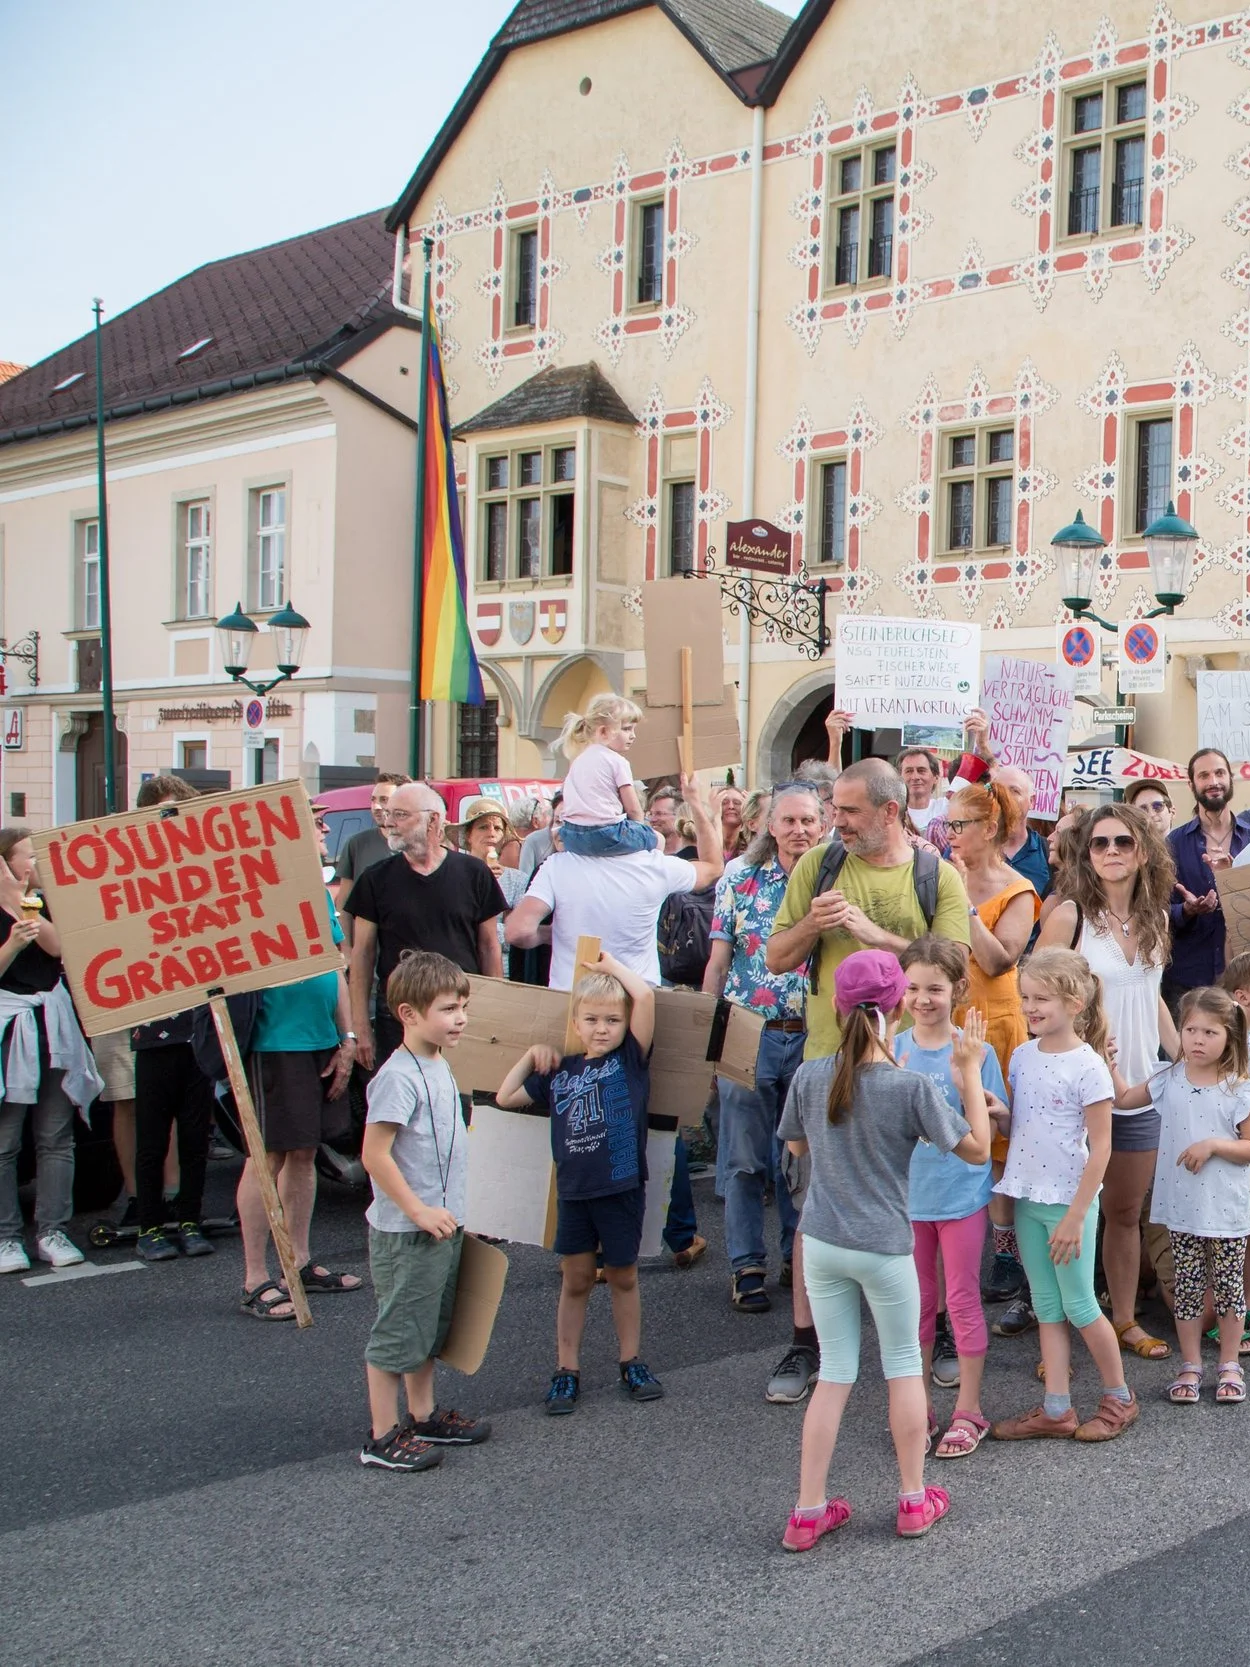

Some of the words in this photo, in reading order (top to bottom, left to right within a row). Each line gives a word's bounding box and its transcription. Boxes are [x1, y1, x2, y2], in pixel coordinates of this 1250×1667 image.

[730, 536, 788, 559] alexander
[843, 625, 956, 643] STEINBRUCHSEE
[846, 646, 872, 657] NSG
[874, 646, 949, 660] TEUFELSTEIN
[845, 674, 890, 687] SANFTE
[894, 675, 952, 689] NUTZUNG
[1001, 660, 1055, 684] NATUR-
[840, 697, 860, 713] MIT
[864, 697, 973, 716] VERANTWORTUNG
[1094, 711, 1134, 721] Parkscheine
[1202, 702, 1232, 727] AM
[989, 723, 1051, 749] NUTZUNG
[1001, 745, 1036, 766] STATT
[1073, 750, 1114, 775] SEE
[48, 795, 301, 886] LÖSUNGEN
[99, 849, 281, 921] FINDEN
[147, 889, 265, 945] STATT
[567, 1084, 604, 1136] 41
